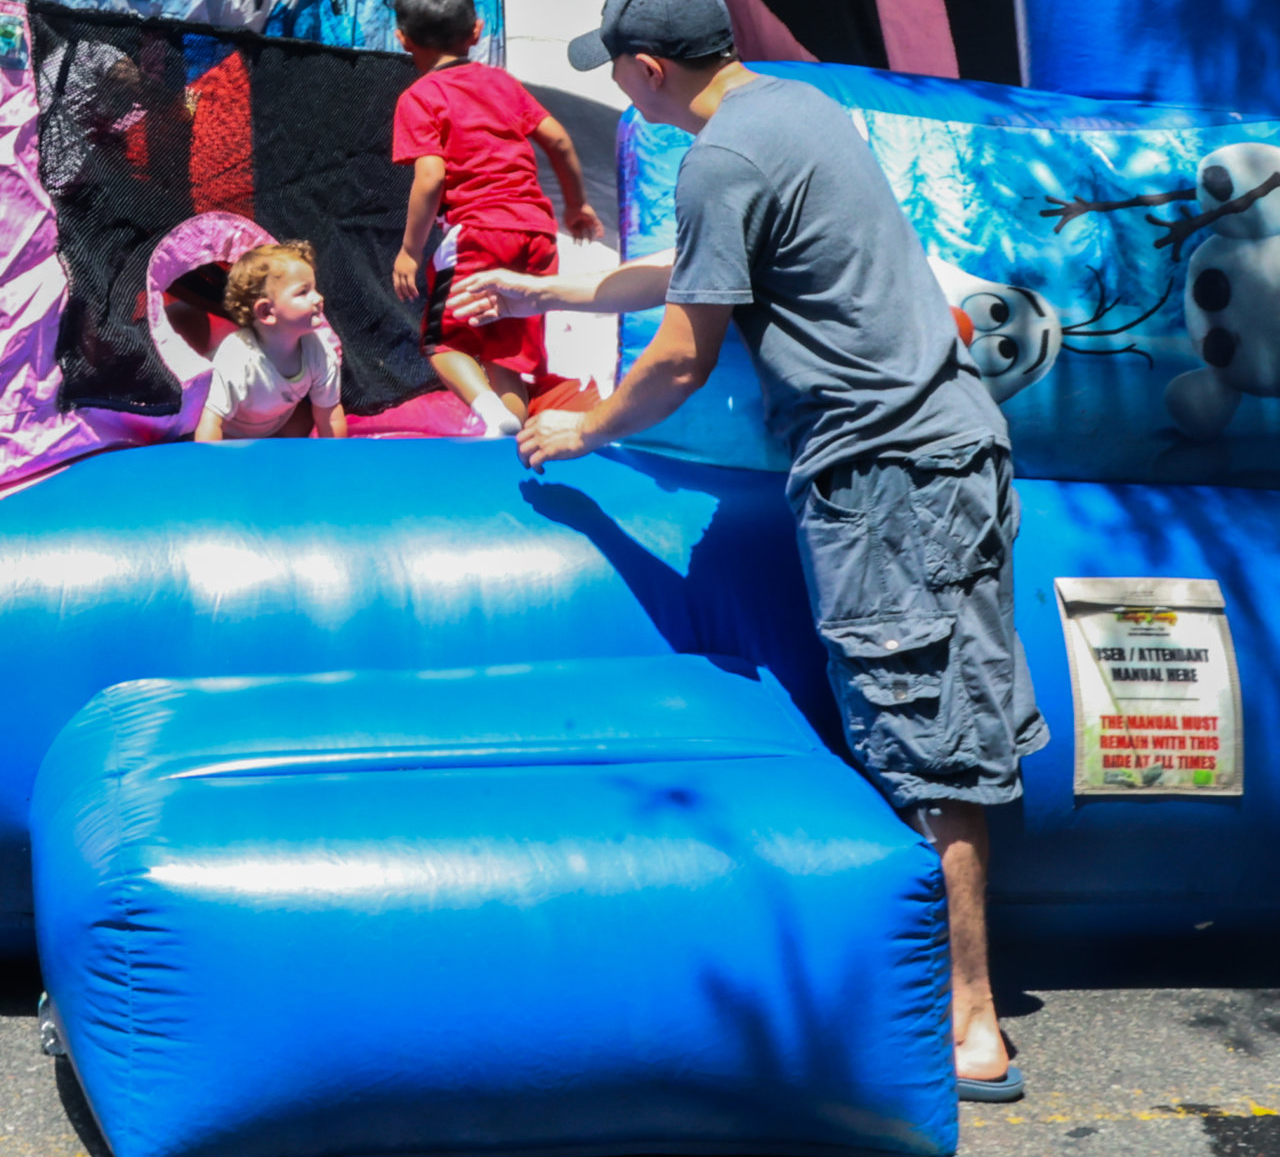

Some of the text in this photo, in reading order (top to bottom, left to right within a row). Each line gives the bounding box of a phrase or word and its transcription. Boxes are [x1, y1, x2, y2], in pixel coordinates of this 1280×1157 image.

[1137, 647, 1209, 662] ATTENDANT
[1111, 667, 1199, 683] MANUAL HERE
[1099, 715, 1219, 731] THE MANUAL MUST
[1099, 735, 1220, 751] REMAIN WITH THIS
[1102, 754, 1132, 769] RIDE
[1134, 754, 1151, 769] AT
[1177, 755, 1217, 770] TIMES
